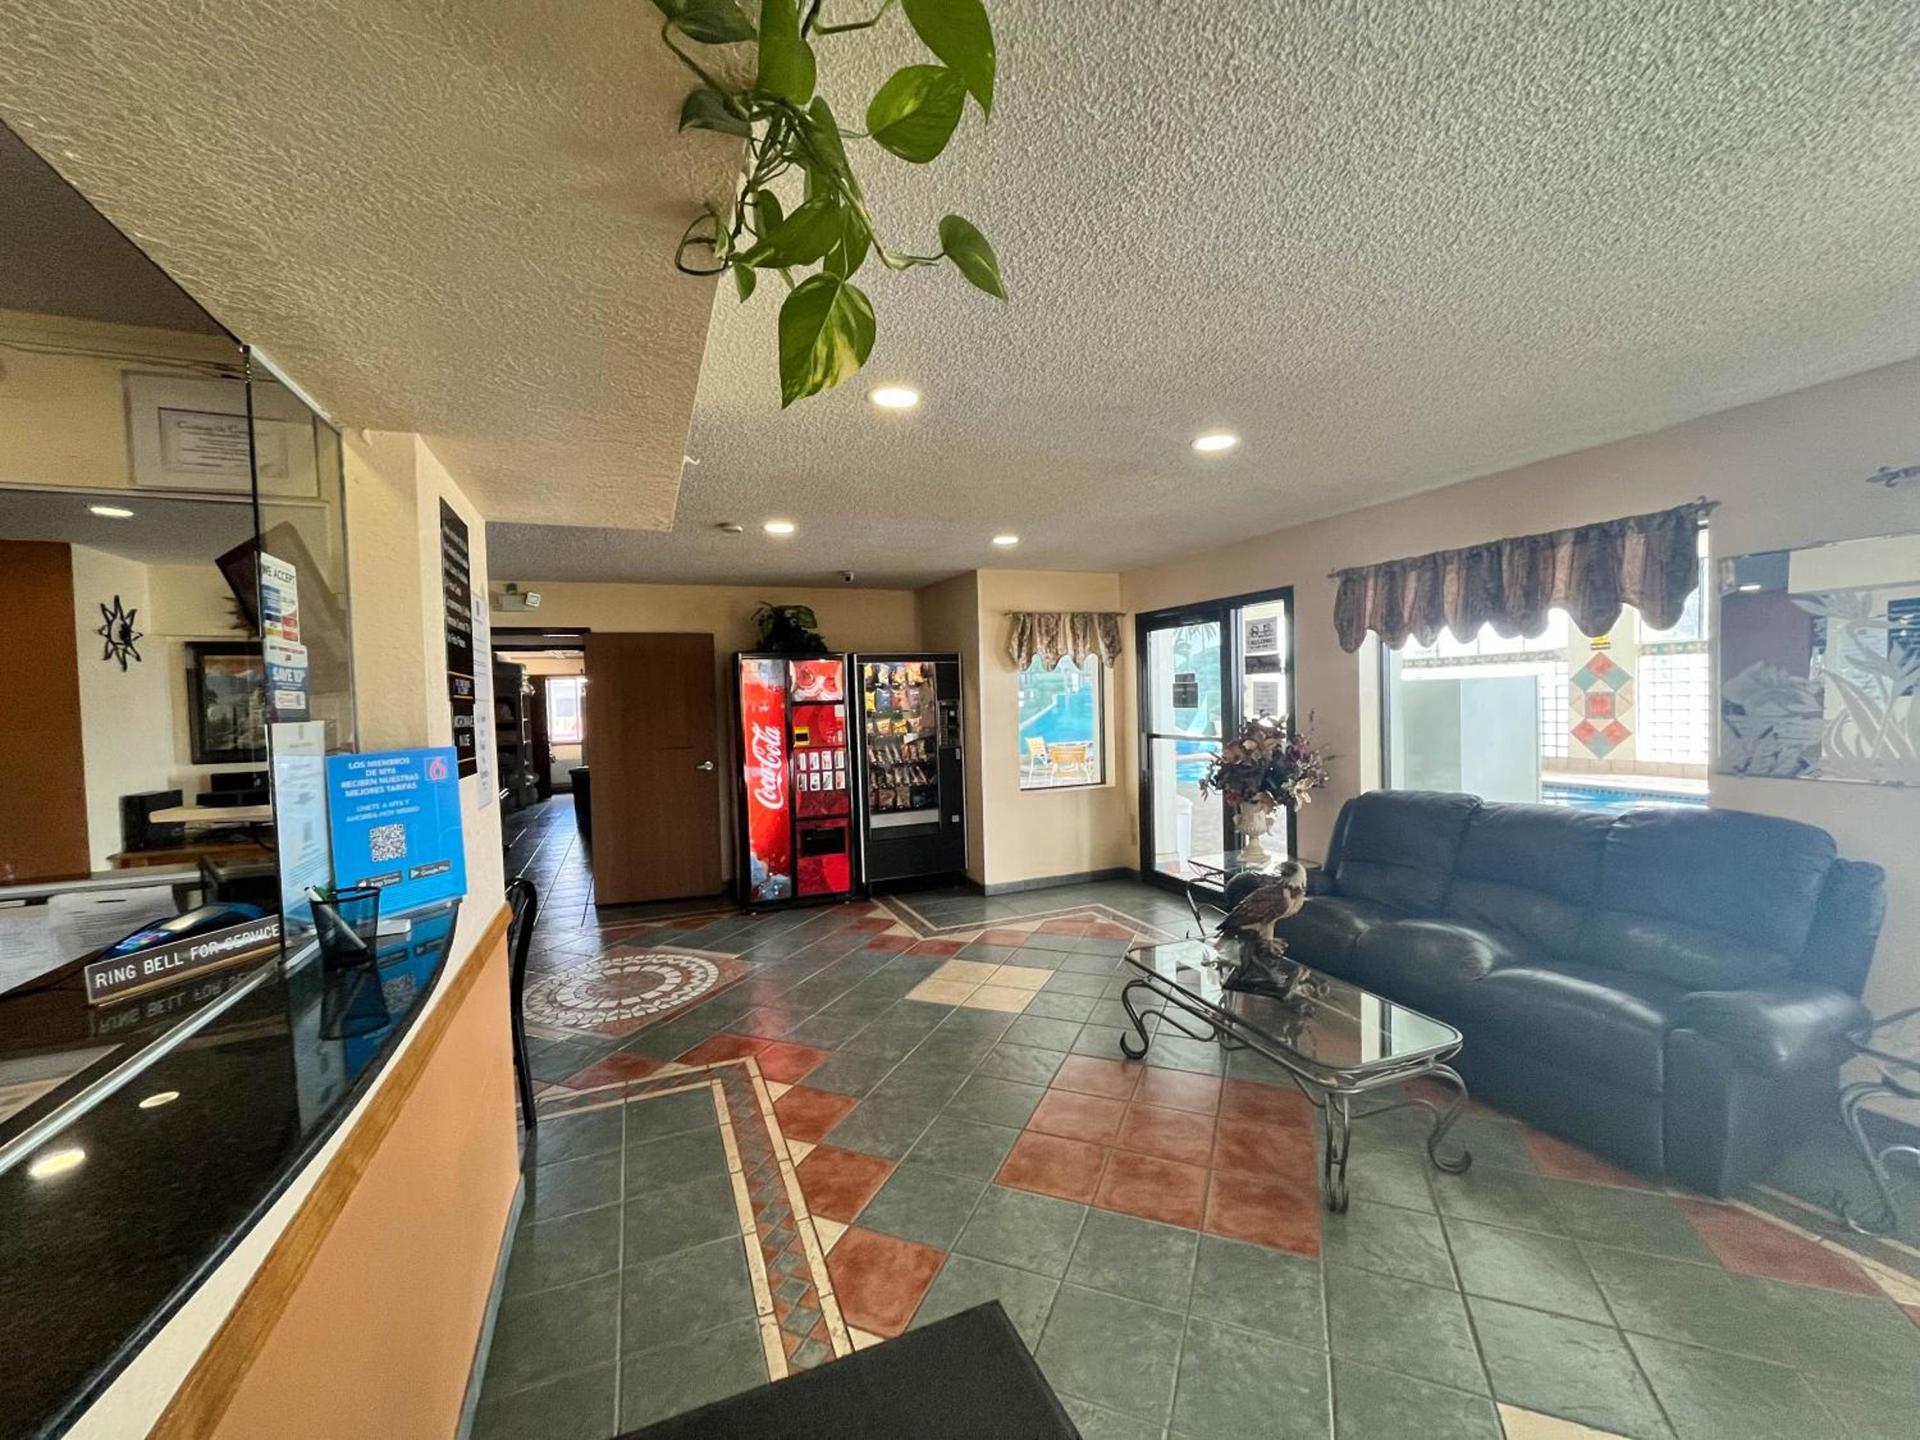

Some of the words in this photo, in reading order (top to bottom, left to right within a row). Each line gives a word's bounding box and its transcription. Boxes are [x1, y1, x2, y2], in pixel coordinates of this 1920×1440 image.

[272, 667, 293, 681] SAVE
[348, 761, 366, 770] LOS
[367, 757, 410, 767] MIEMBROS
[366, 769, 377, 777] DE
[341, 778, 378, 789] RECIBEN
[380, 773, 419, 784] NUESTRAS
[345, 787, 385, 797] MEJORES
[386, 782, 417, 792] TARIFAS
[95, 966, 137, 989] RING
[143, 952, 185, 975] BELL
[190, 941, 219, 961] FOR
[223, 923, 280, 948] SERVICE
